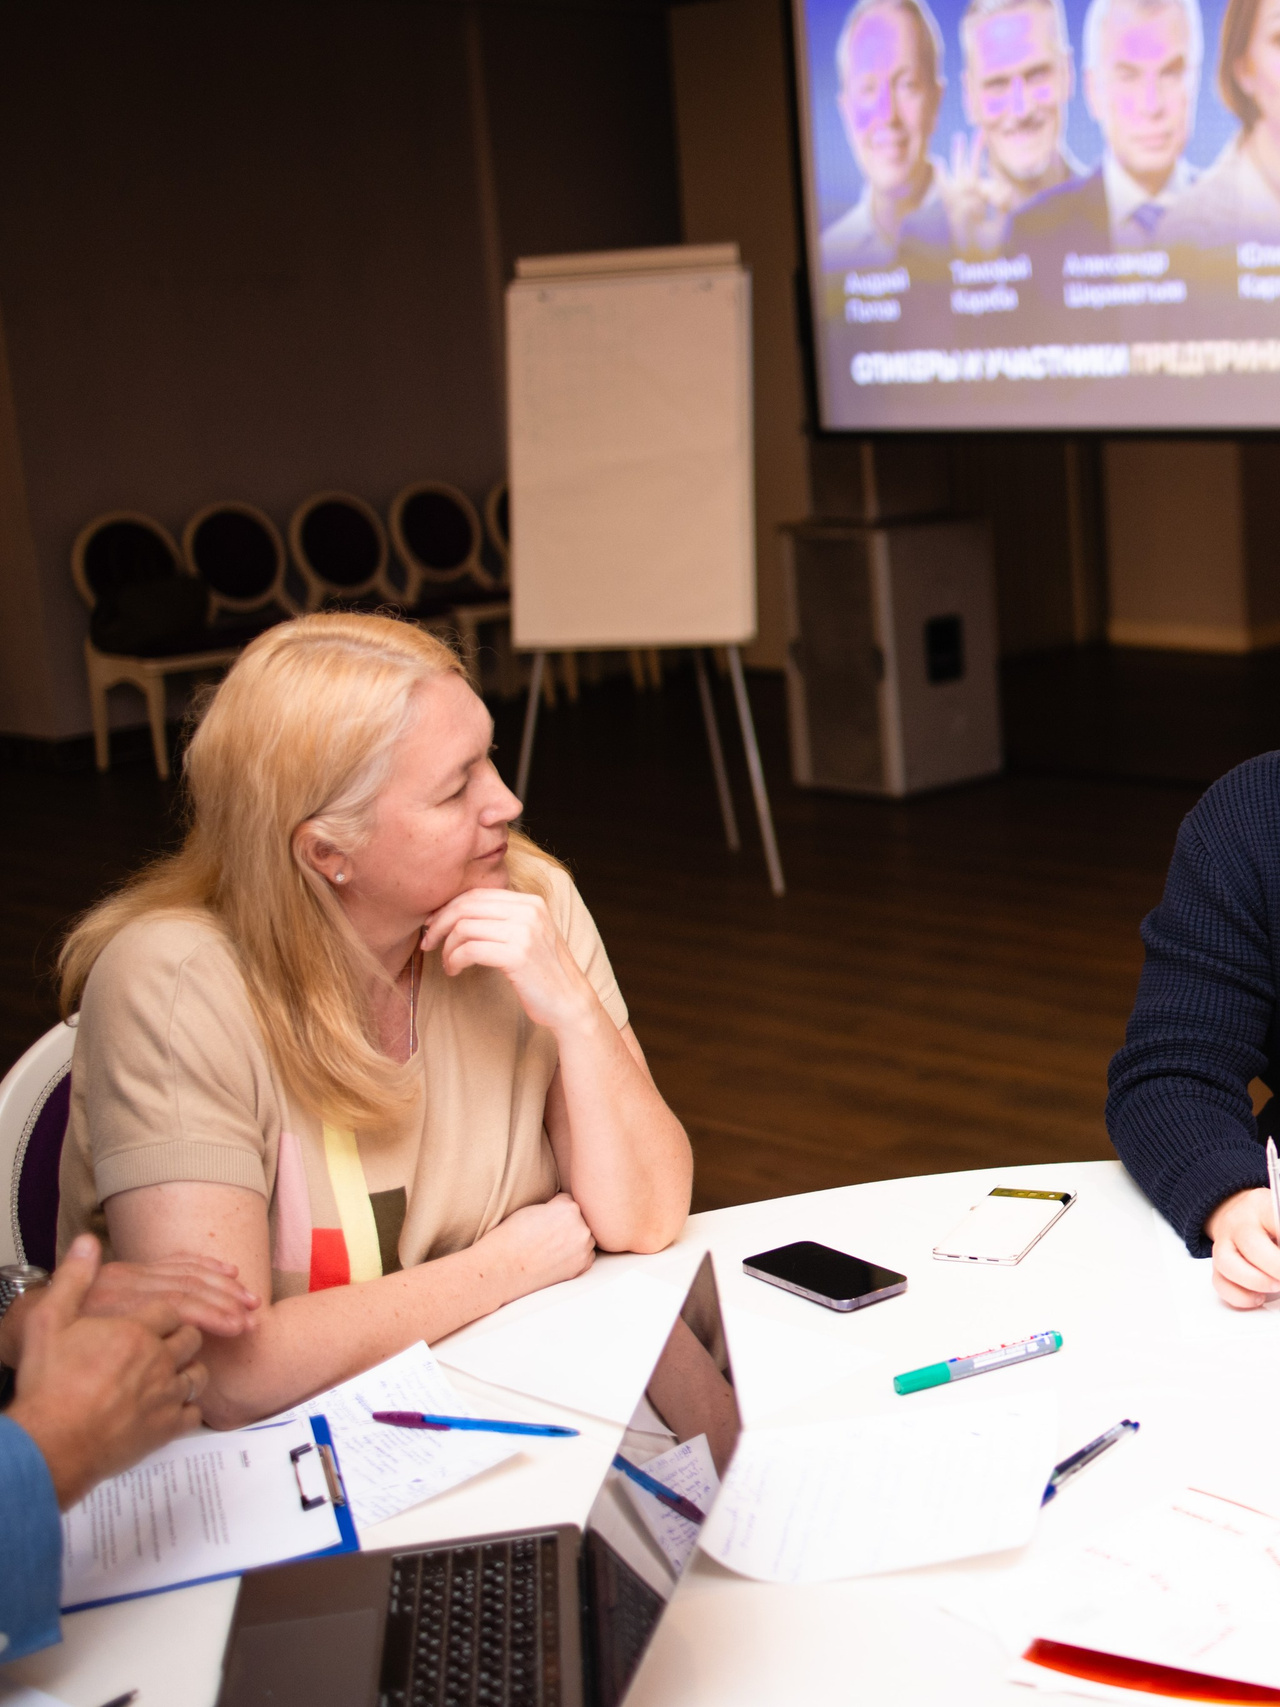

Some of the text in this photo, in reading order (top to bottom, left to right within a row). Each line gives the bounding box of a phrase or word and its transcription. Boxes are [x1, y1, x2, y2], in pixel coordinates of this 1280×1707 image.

[1062, 251, 1169, 277] Александр
[844, 268, 909, 297] Андрей
[851, 350, 959, 385] СПИКЕРЫ
[984, 343, 1130, 381] УЧАСТНИКИ
